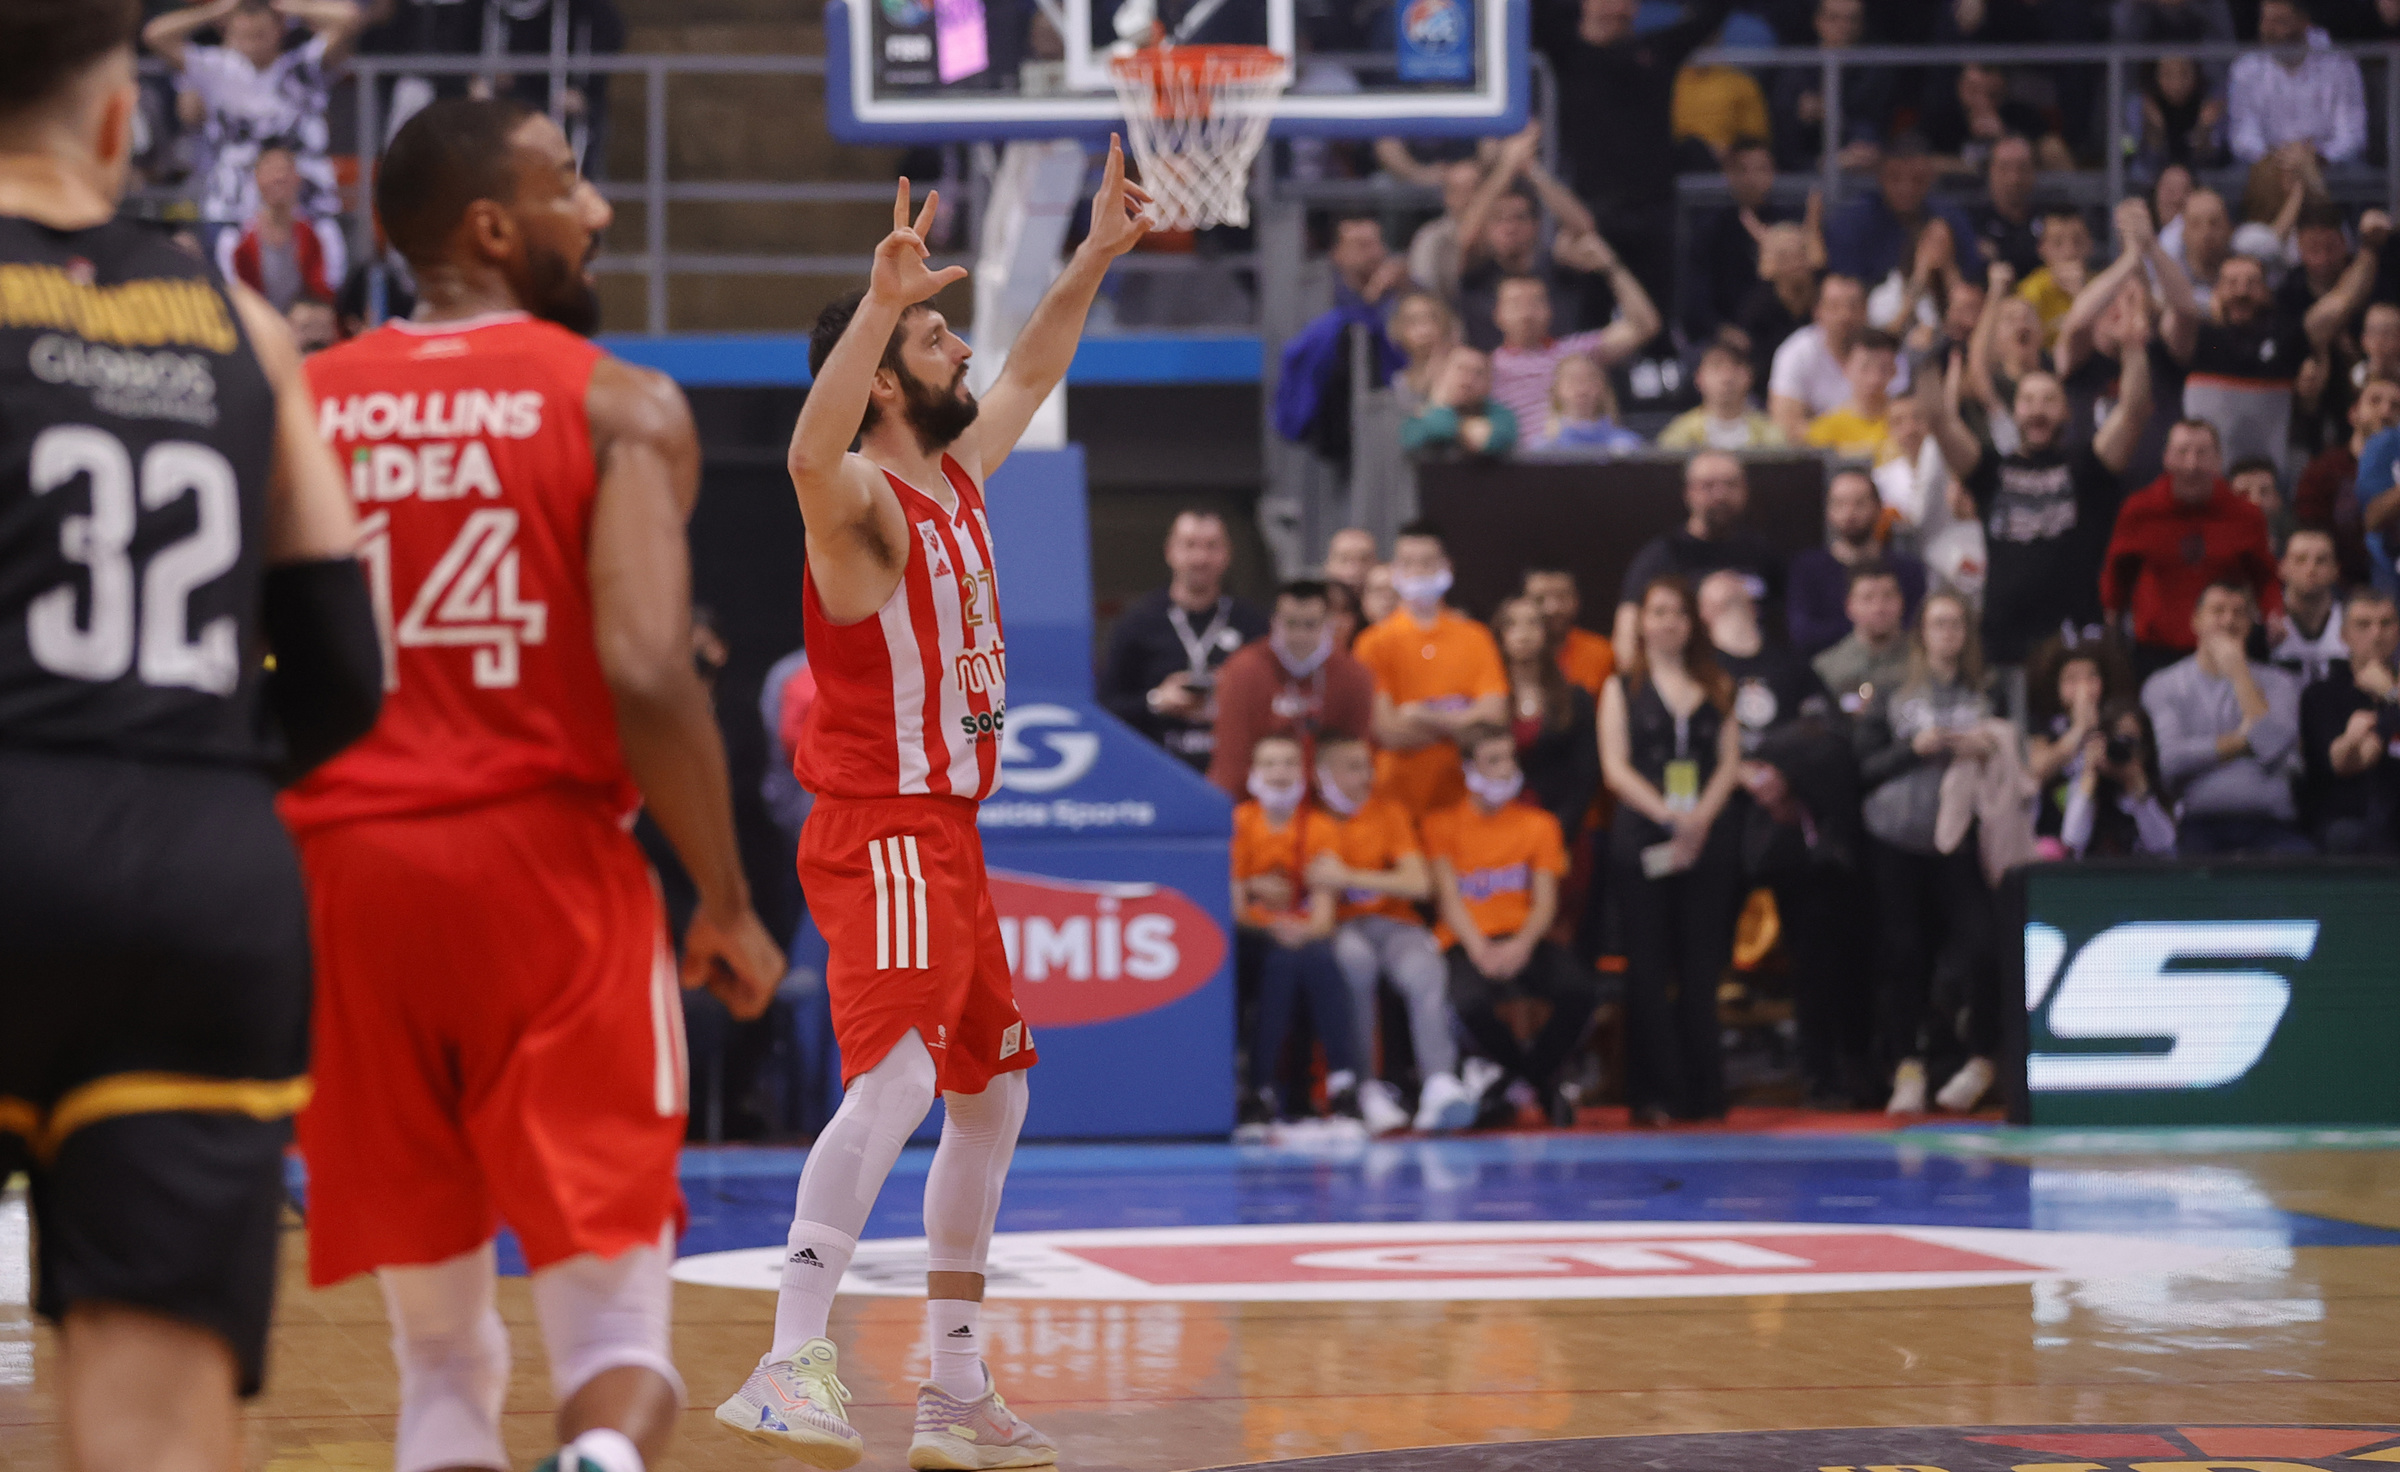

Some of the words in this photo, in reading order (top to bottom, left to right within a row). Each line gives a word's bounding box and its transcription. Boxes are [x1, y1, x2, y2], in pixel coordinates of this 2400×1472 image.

[320, 389, 543, 441] HOLLINS
[28, 424, 240, 697] 32
[355, 508, 546, 693] 14
[961, 569, 996, 628] 27
